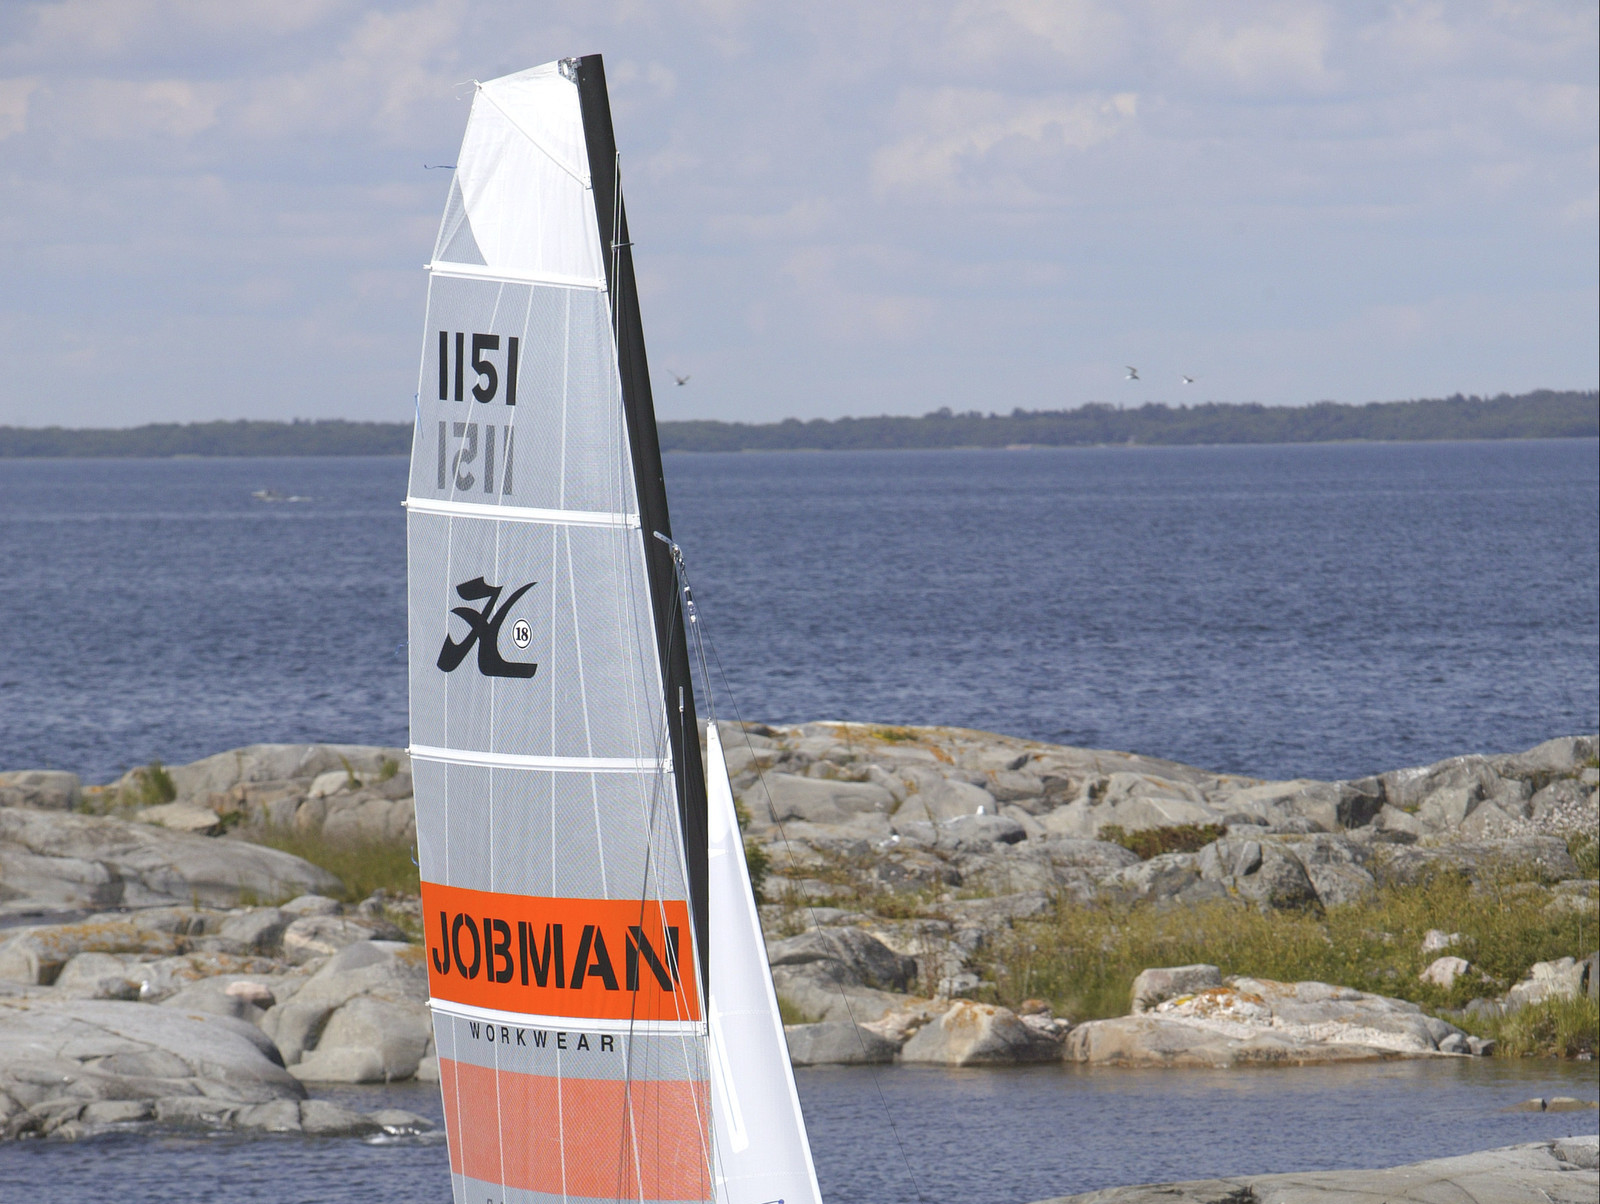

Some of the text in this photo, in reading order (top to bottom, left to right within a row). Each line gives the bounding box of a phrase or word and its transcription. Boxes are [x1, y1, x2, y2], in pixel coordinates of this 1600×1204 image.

[439, 331, 519, 406] 1151
[515, 627, 529, 642] 18
[432, 911, 679, 992] JOBMAN
[470, 1022, 614, 1052] WORKWEAR
